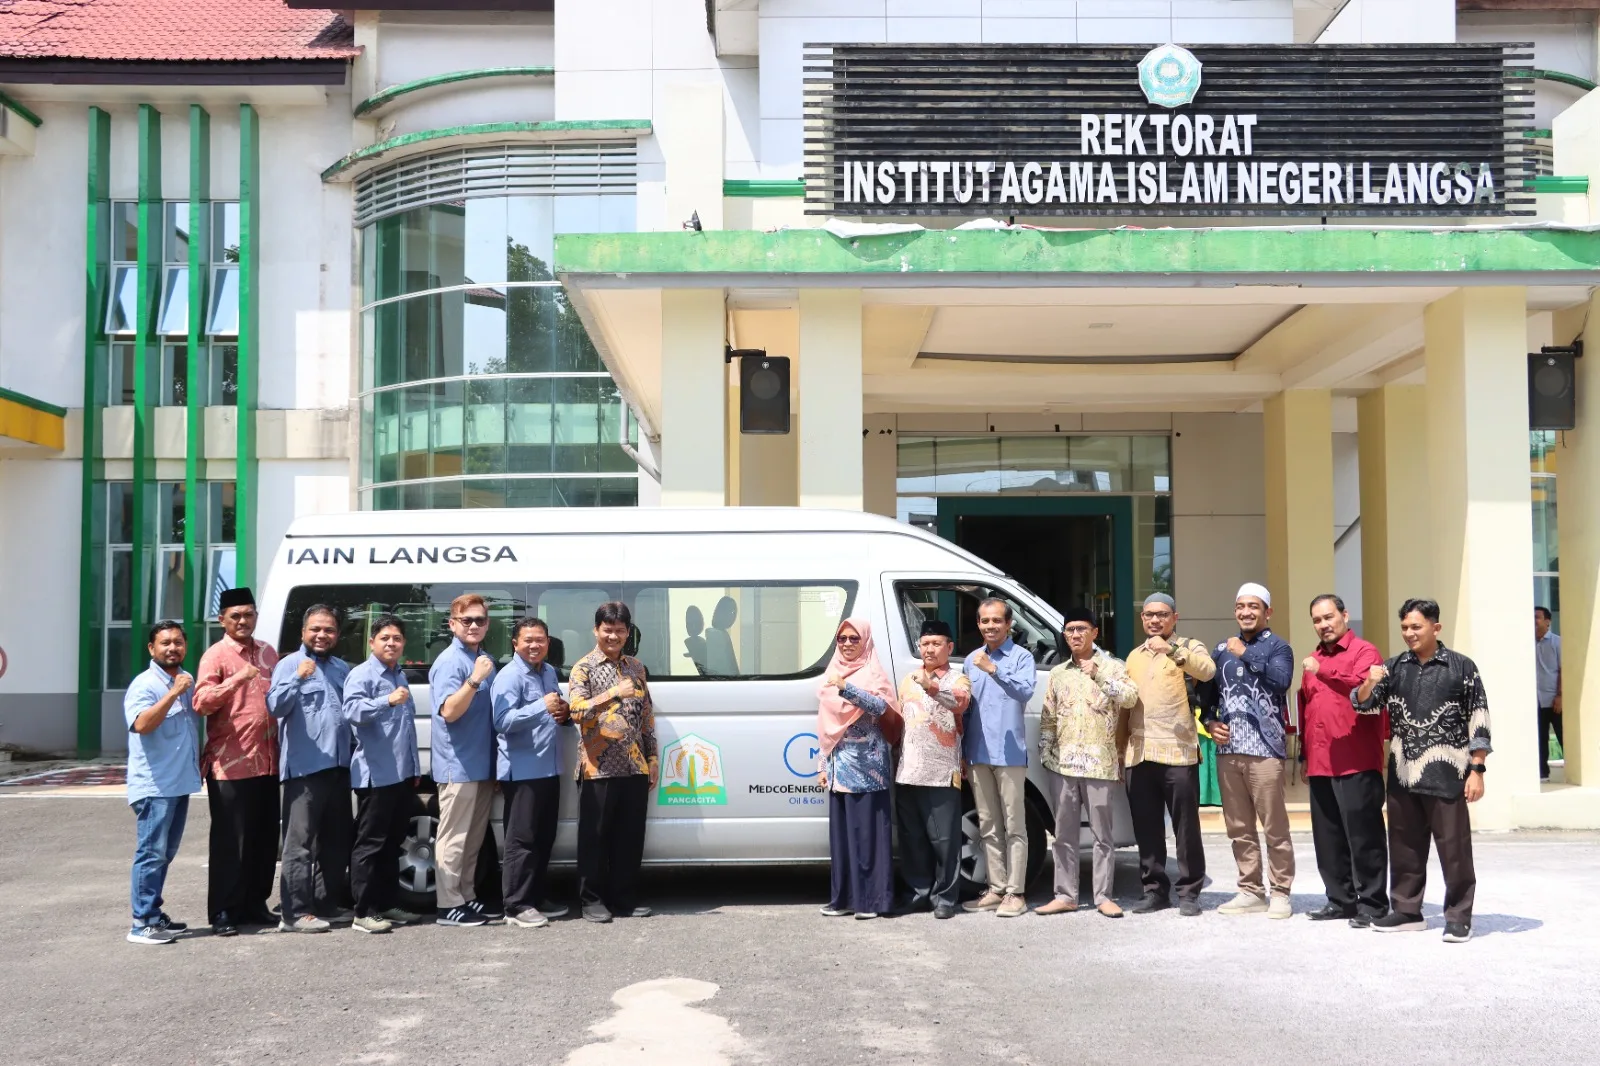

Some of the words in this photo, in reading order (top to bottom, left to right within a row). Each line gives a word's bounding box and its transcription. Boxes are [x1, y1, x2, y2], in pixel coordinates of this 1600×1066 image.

[1080, 113, 1257, 157] REKTORAT
[843, 161, 996, 204] INSTITUT
[1000, 161, 1118, 204] AGAMA
[1127, 161, 1229, 205] ISLAM
[1237, 161, 1354, 205] NEGERI
[1363, 162, 1496, 205] LANGSA
[287, 547, 354, 565] IAIN
[369, 545, 518, 564] LANGSA
[667, 796, 717, 804] PANCACITA
[789, 797, 801, 805] Oil
[802, 797, 809, 805] &
[810, 797, 825, 805] Gas
